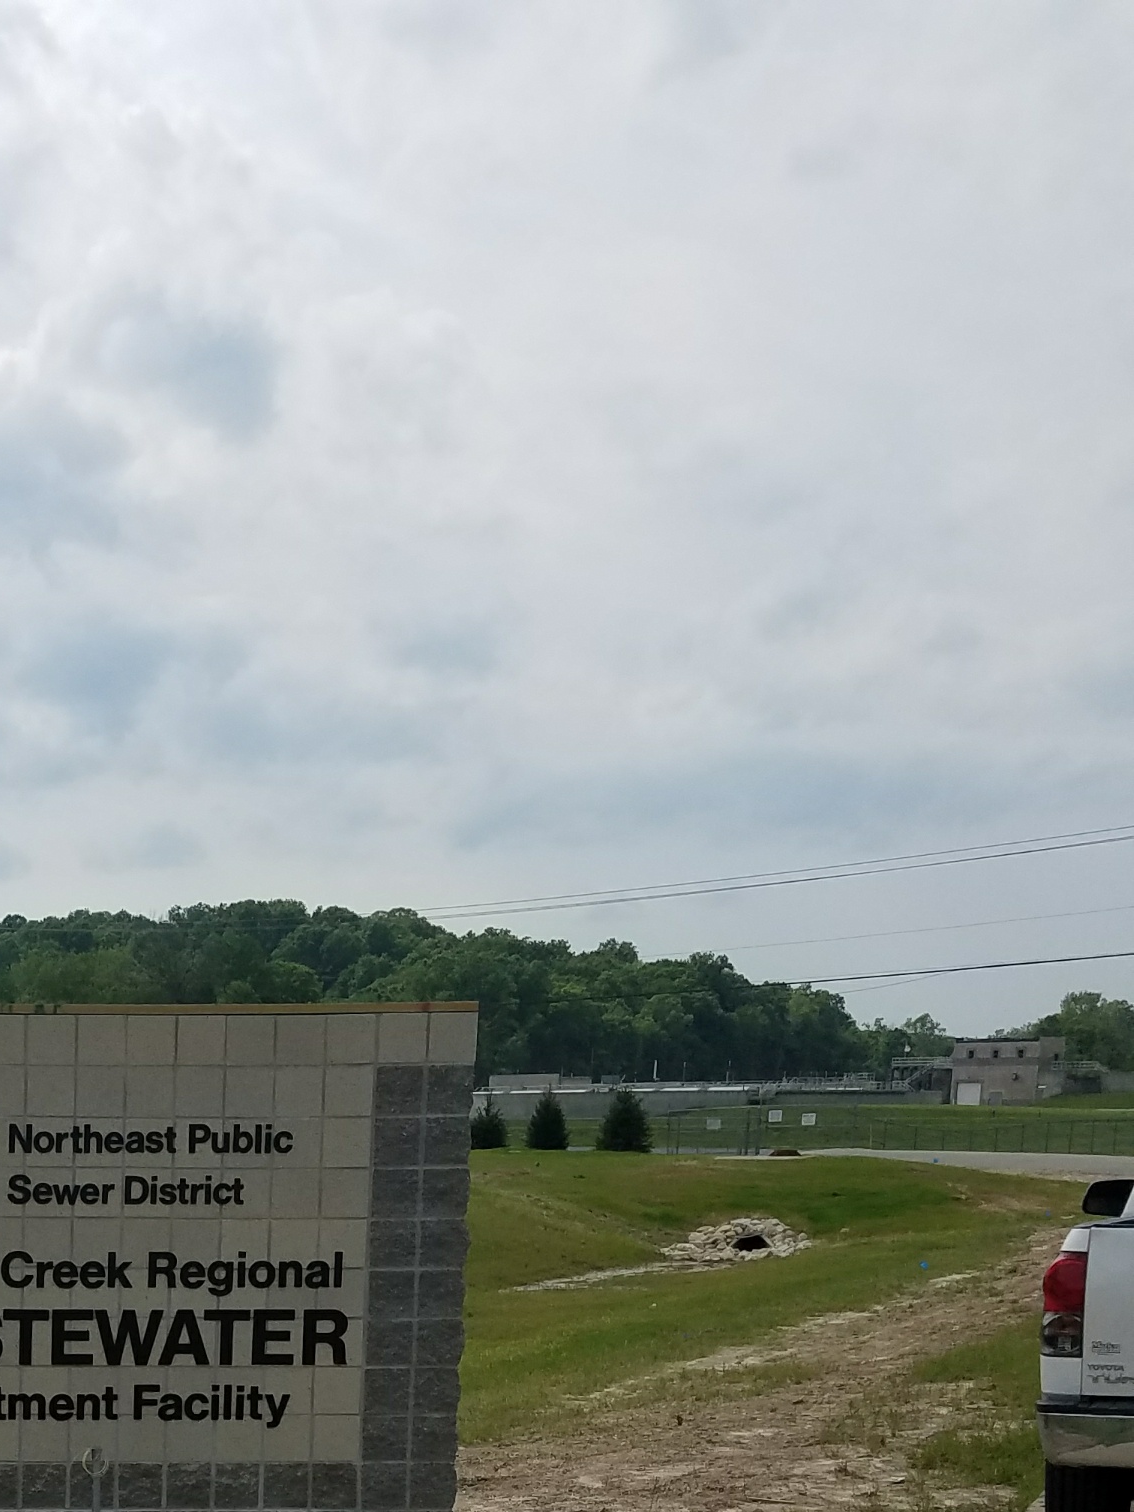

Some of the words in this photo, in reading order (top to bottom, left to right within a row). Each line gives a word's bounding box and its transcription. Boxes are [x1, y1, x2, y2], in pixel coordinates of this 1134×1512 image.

[7, 1123, 177, 1155] Northeast
[188, 1124, 294, 1155] Public
[7, 1174, 115, 1206] Sewer
[123, 1175, 245, 1206] District
[0, 1250, 133, 1290] Creek
[147, 1250, 344, 1298] Regional
[1087, 1363, 1124, 1371] TOYOTA
[132, 1384, 291, 1428] Facility
